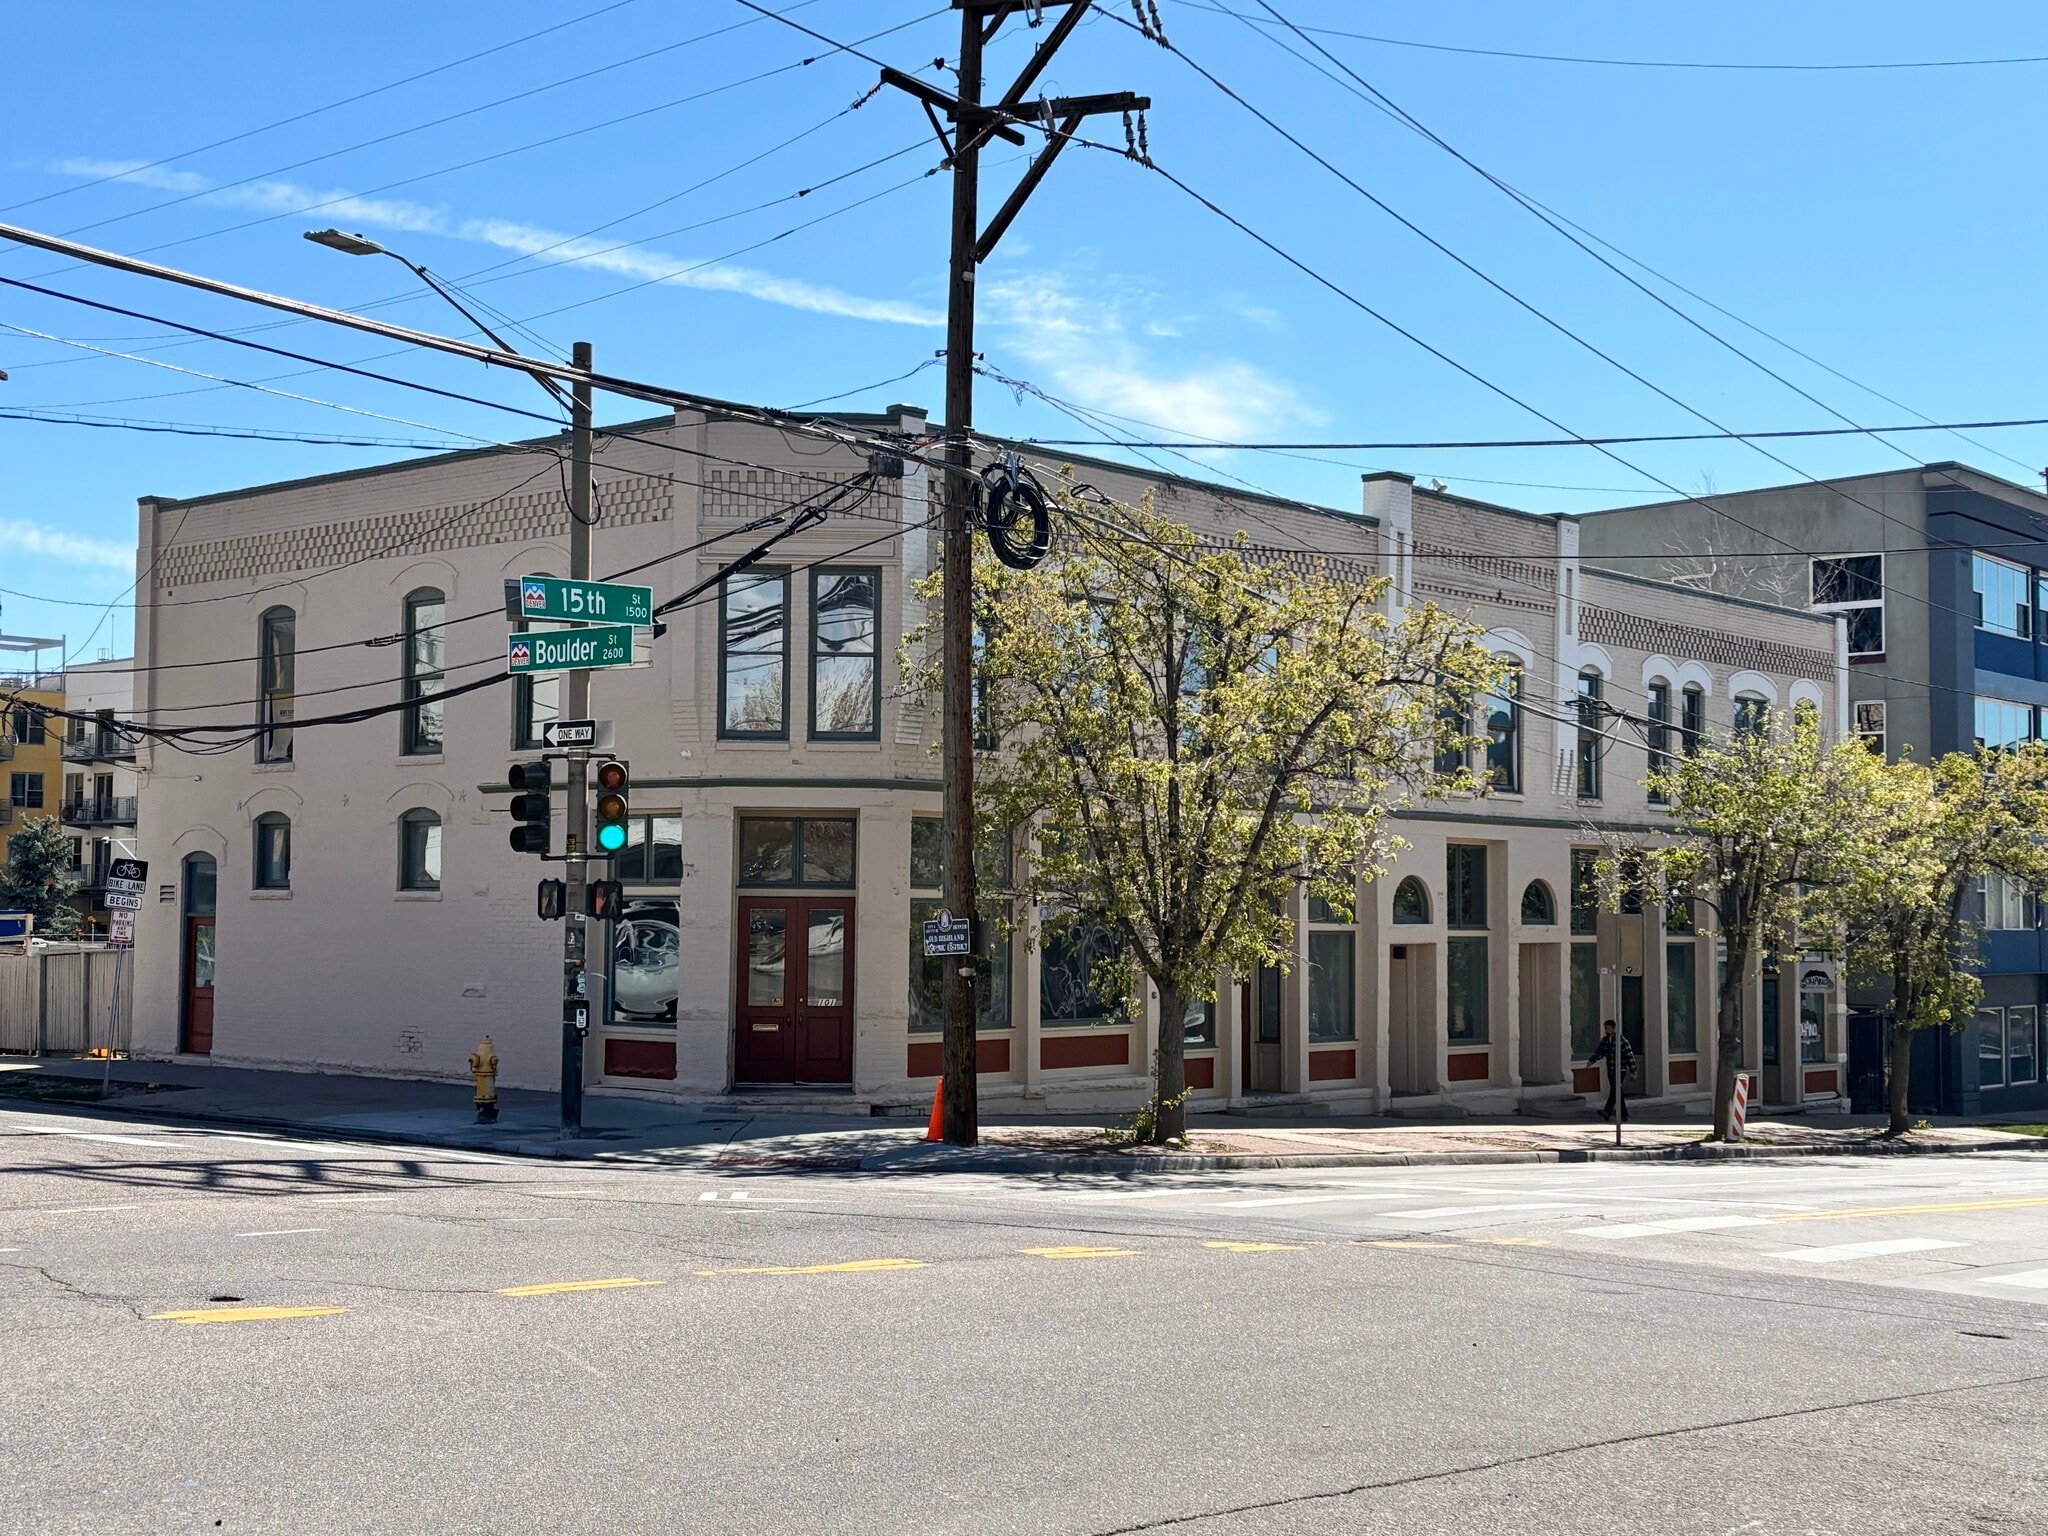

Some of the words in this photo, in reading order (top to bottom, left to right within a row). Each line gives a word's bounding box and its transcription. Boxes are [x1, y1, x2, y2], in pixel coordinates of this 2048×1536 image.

[526, 600, 546, 608] DENVER
[561, 587, 606, 615] 15th
[632, 594, 641, 605] St
[625, 606, 647, 618] 1500
[536, 638, 597, 664] Boulder
[608, 634, 617, 645] St
[603, 648, 624, 660] 2600
[511, 657, 530, 665] DENVER
[558, 729, 573, 740] ONE
[575, 728, 590, 739] WAY
[108, 879, 124, 889] BIKE
[127, 882, 145, 891] LANE
[109, 896, 139, 907] BEGINS
[928, 935, 938, 943] OLD
[818, 998, 836, 1006] 101
